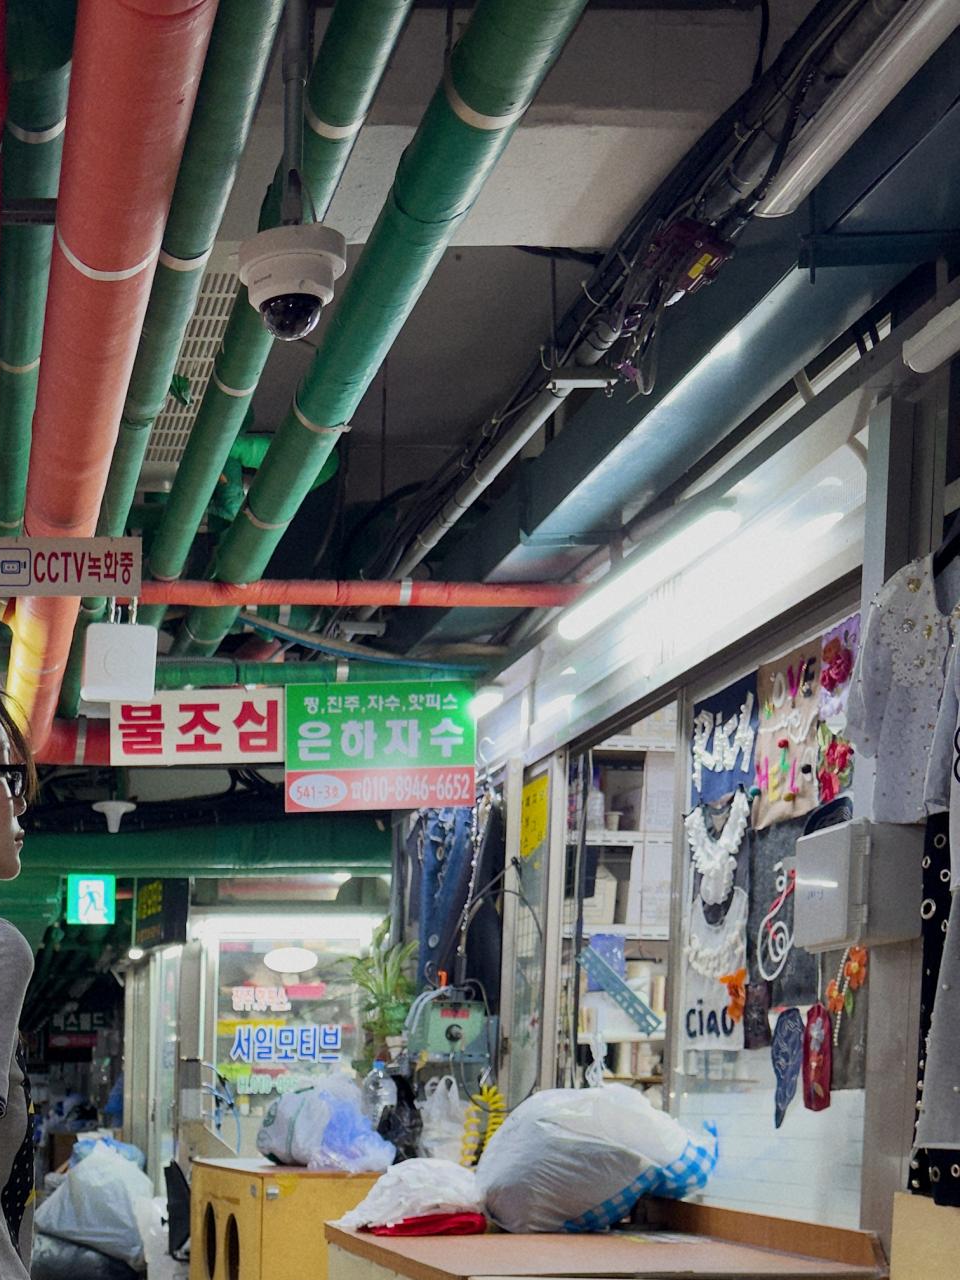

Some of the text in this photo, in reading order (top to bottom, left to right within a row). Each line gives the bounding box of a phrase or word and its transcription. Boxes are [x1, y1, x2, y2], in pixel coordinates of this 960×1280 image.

[33, 550, 134, 585] CCTV녹화중
[118, 700, 279, 755] 불조심
[297, 718, 464, 762] 은하자수
[362, 773, 470, 802] 010-8946-6652
[231, 1025, 341, 1061] 서일모티브
